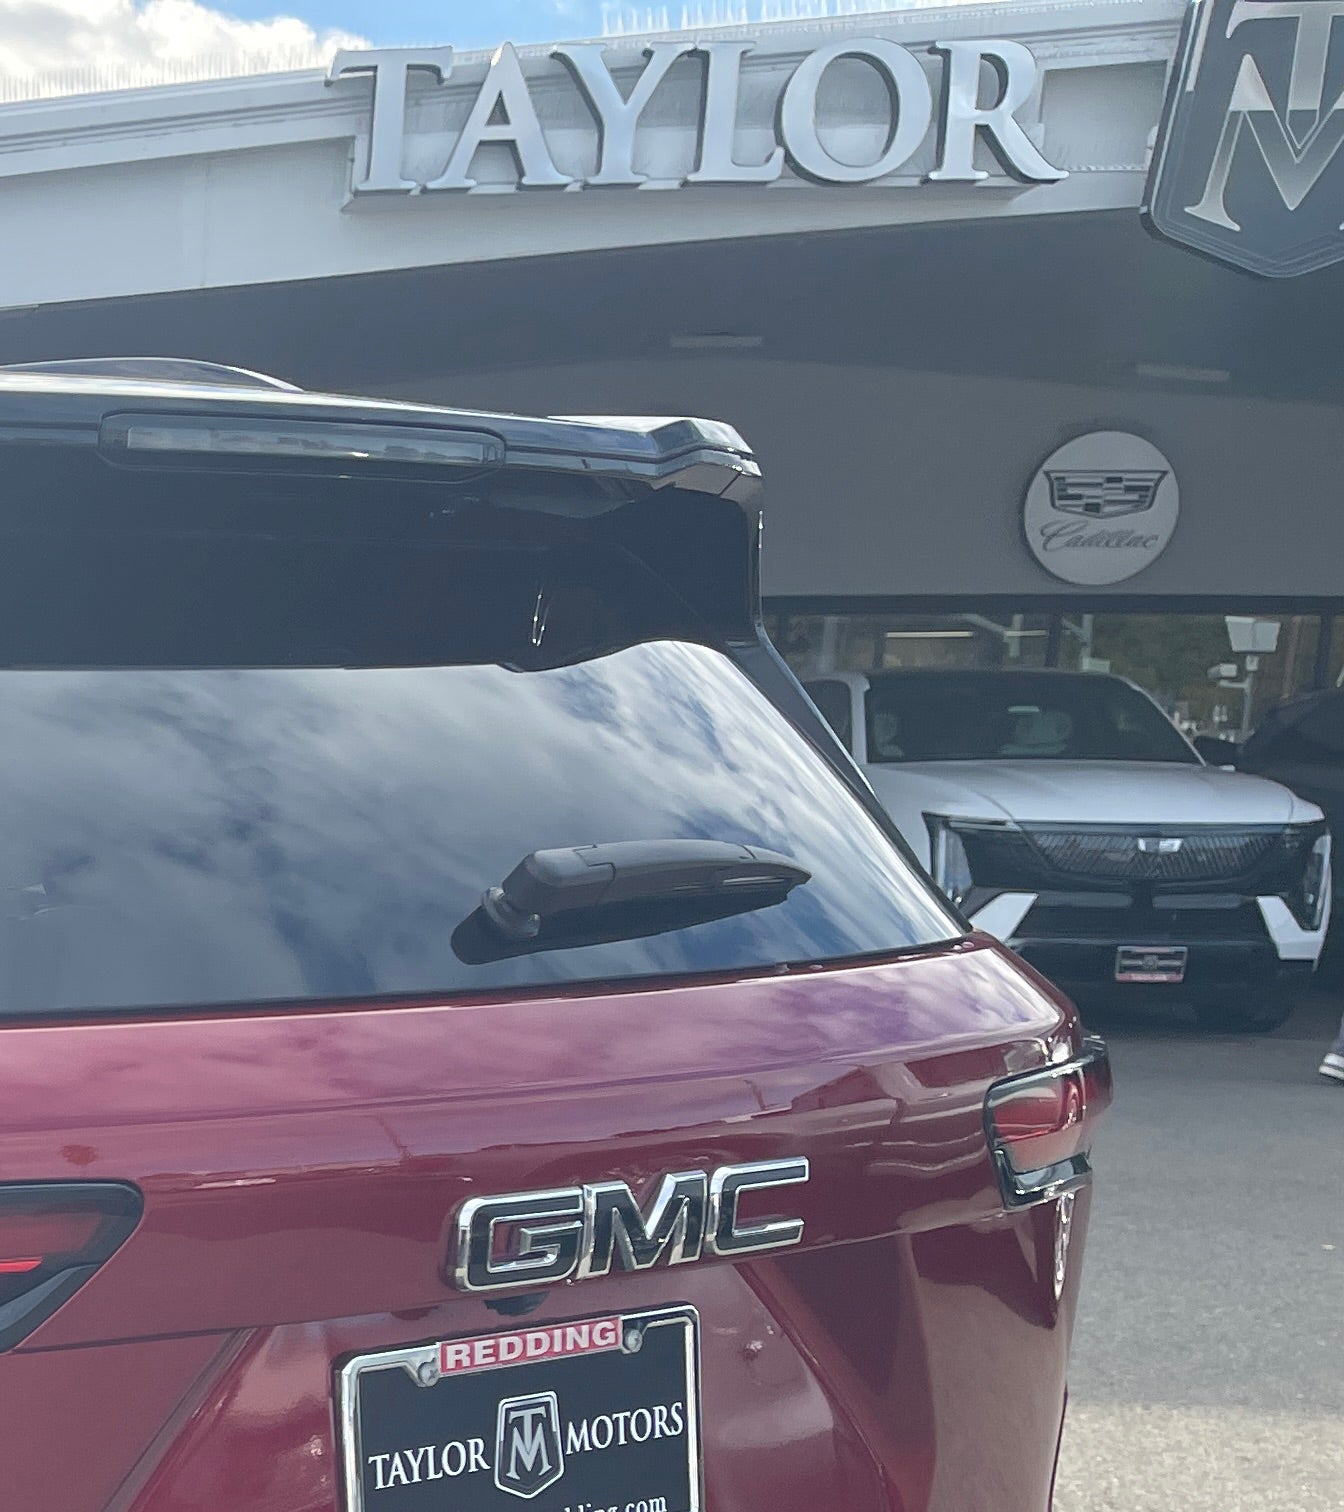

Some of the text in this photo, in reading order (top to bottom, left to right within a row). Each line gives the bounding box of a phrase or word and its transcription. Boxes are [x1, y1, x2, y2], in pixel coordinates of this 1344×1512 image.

[325, 37, 1069, 193] TAYLOR
[1040, 520, 1159, 552] Cadillac
[455, 1156, 811, 1292] GMC
[445, 1321, 618, 1371] REDDING
[368, 1439, 490, 1490] TAYLOR
[565, 1402, 685, 1457] MOTORS
